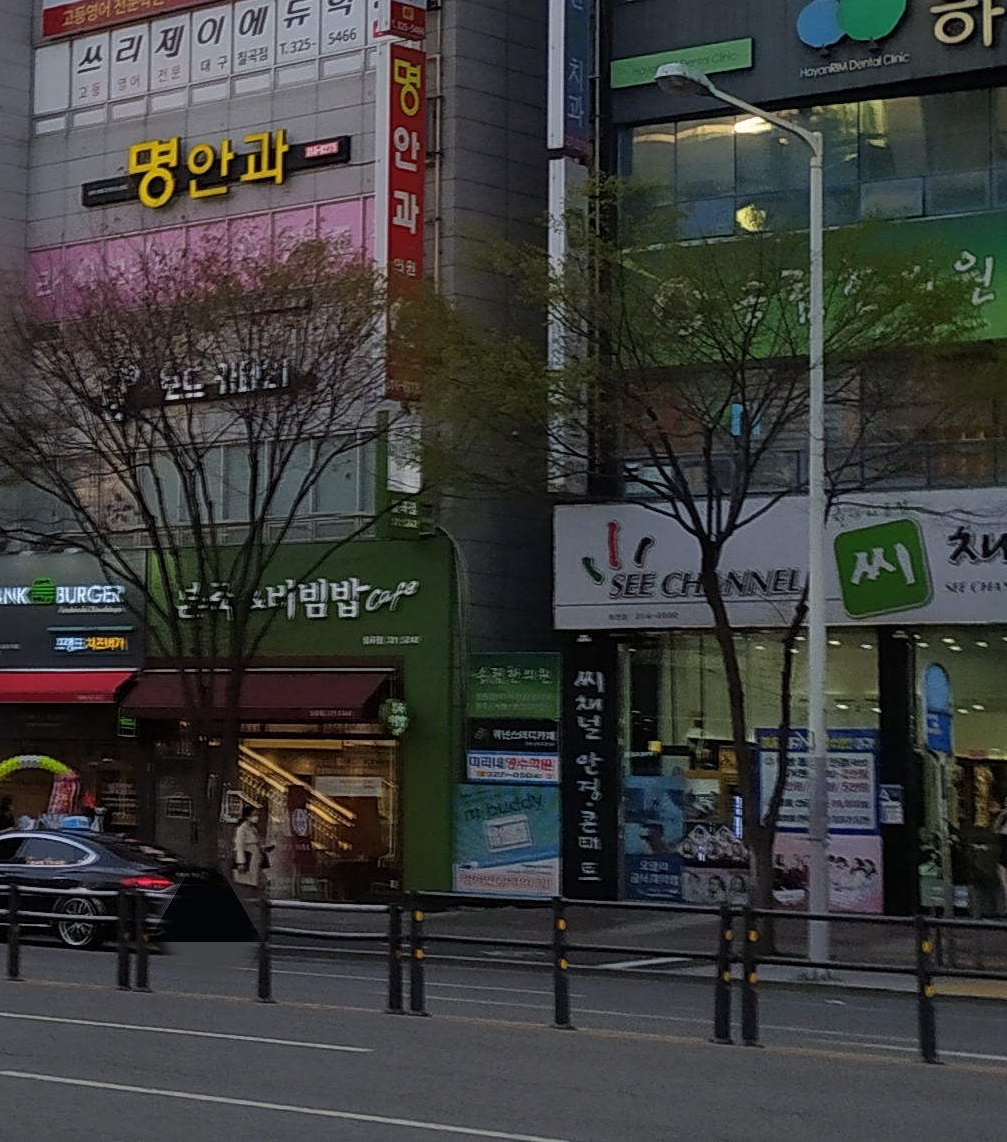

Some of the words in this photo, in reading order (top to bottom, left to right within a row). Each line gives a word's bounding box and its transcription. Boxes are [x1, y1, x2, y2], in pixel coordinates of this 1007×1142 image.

[62, 1, 111, 28] 고등영어
[117, 73, 141, 91] 영어
[157, 64, 182, 83] 전문
[200, 54, 229, 73] 대구
[328, 26, 358, 46] 5466
[850, 55, 881, 71] Dental
[883, 51, 910, 66] Clinic
[394, 59, 422, 235] 명안과
[128, 128, 290, 208] 명안과
[55, 585, 125, 603] BURGER
[364, 580, 420, 612] Cafe
[608, 571, 656, 599] SEE
[660, 568, 803, 598] CHNNEL
